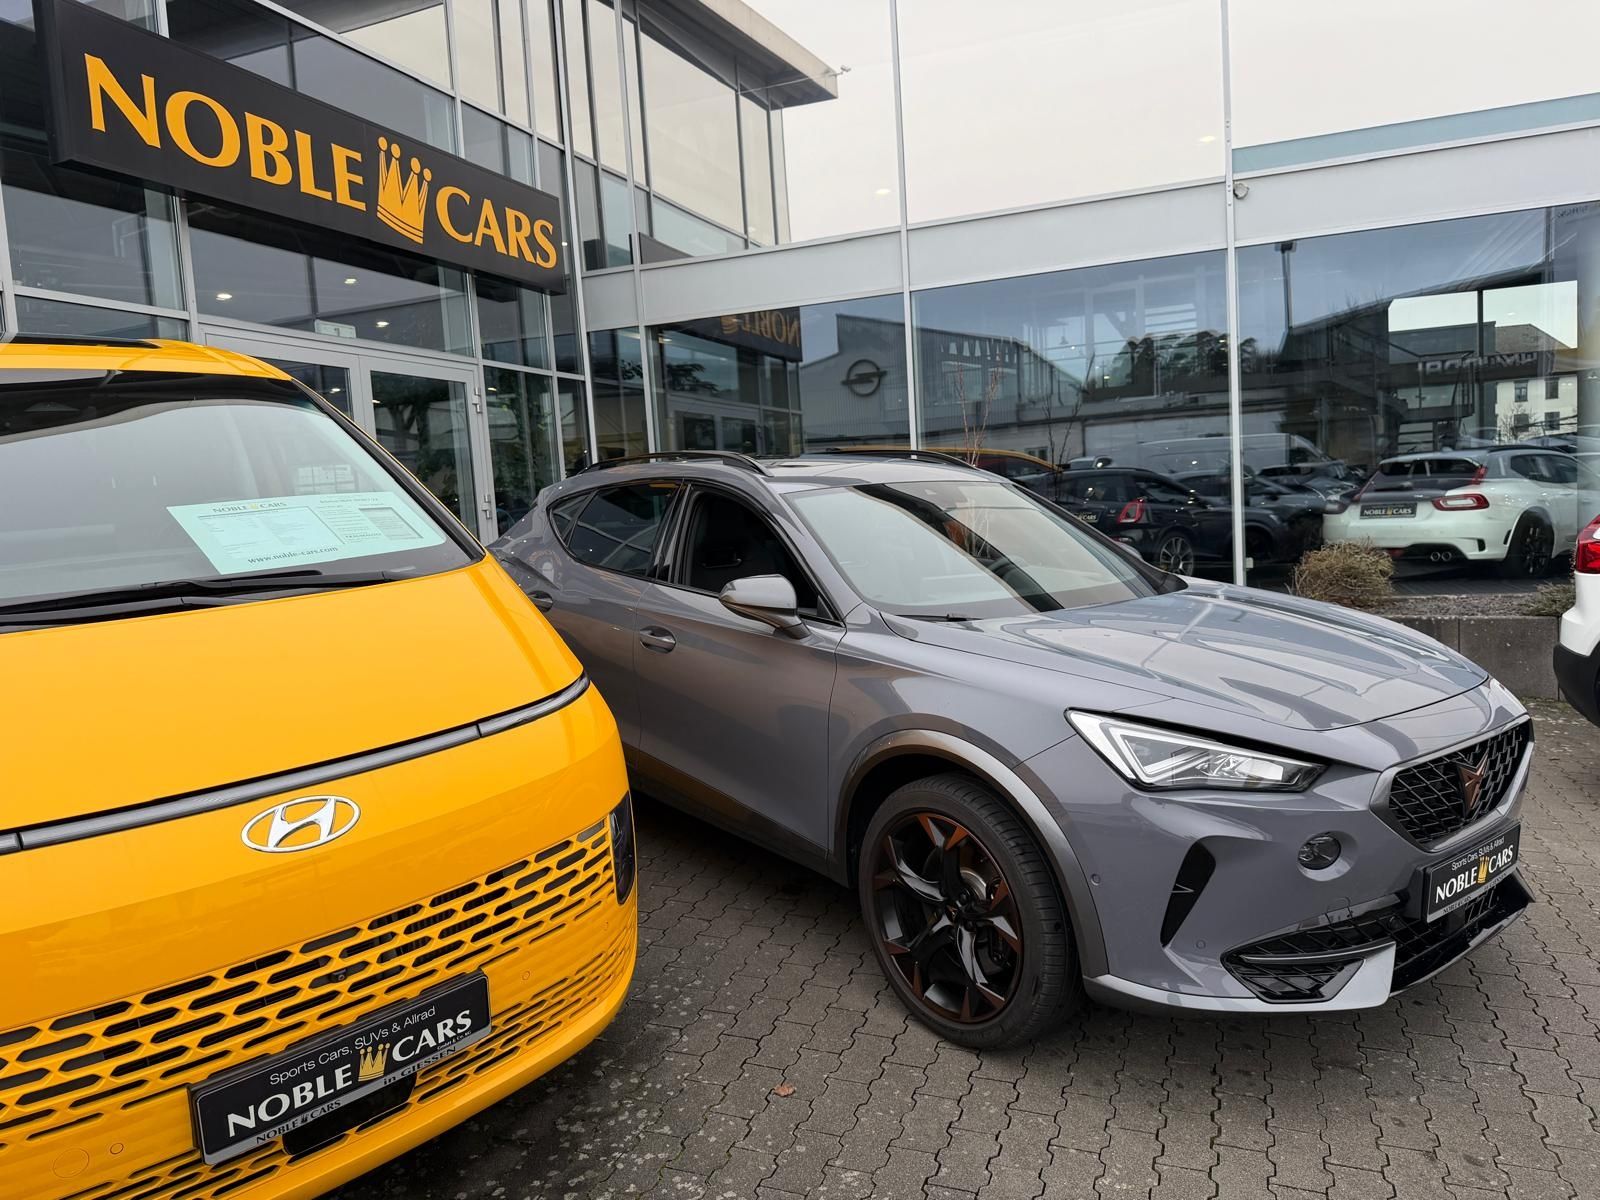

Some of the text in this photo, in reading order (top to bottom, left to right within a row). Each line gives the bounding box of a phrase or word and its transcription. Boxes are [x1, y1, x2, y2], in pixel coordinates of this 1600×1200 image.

[84, 53, 557, 269] NOBLE CARS
[212, 505, 247, 513] NOBLE
[247, 546, 339, 564] www.noble-cars.com
[1436, 867, 1477, 903] NOBLE
[1489, 845, 1513, 873] CARS
[228, 1010, 472, 1138] NOBLE CARS
[269, 1006, 436, 1086] Sports Cars, SUVs & Allrad
[256, 1046, 456, 1144] NOBLE CARS in GIESSEN
